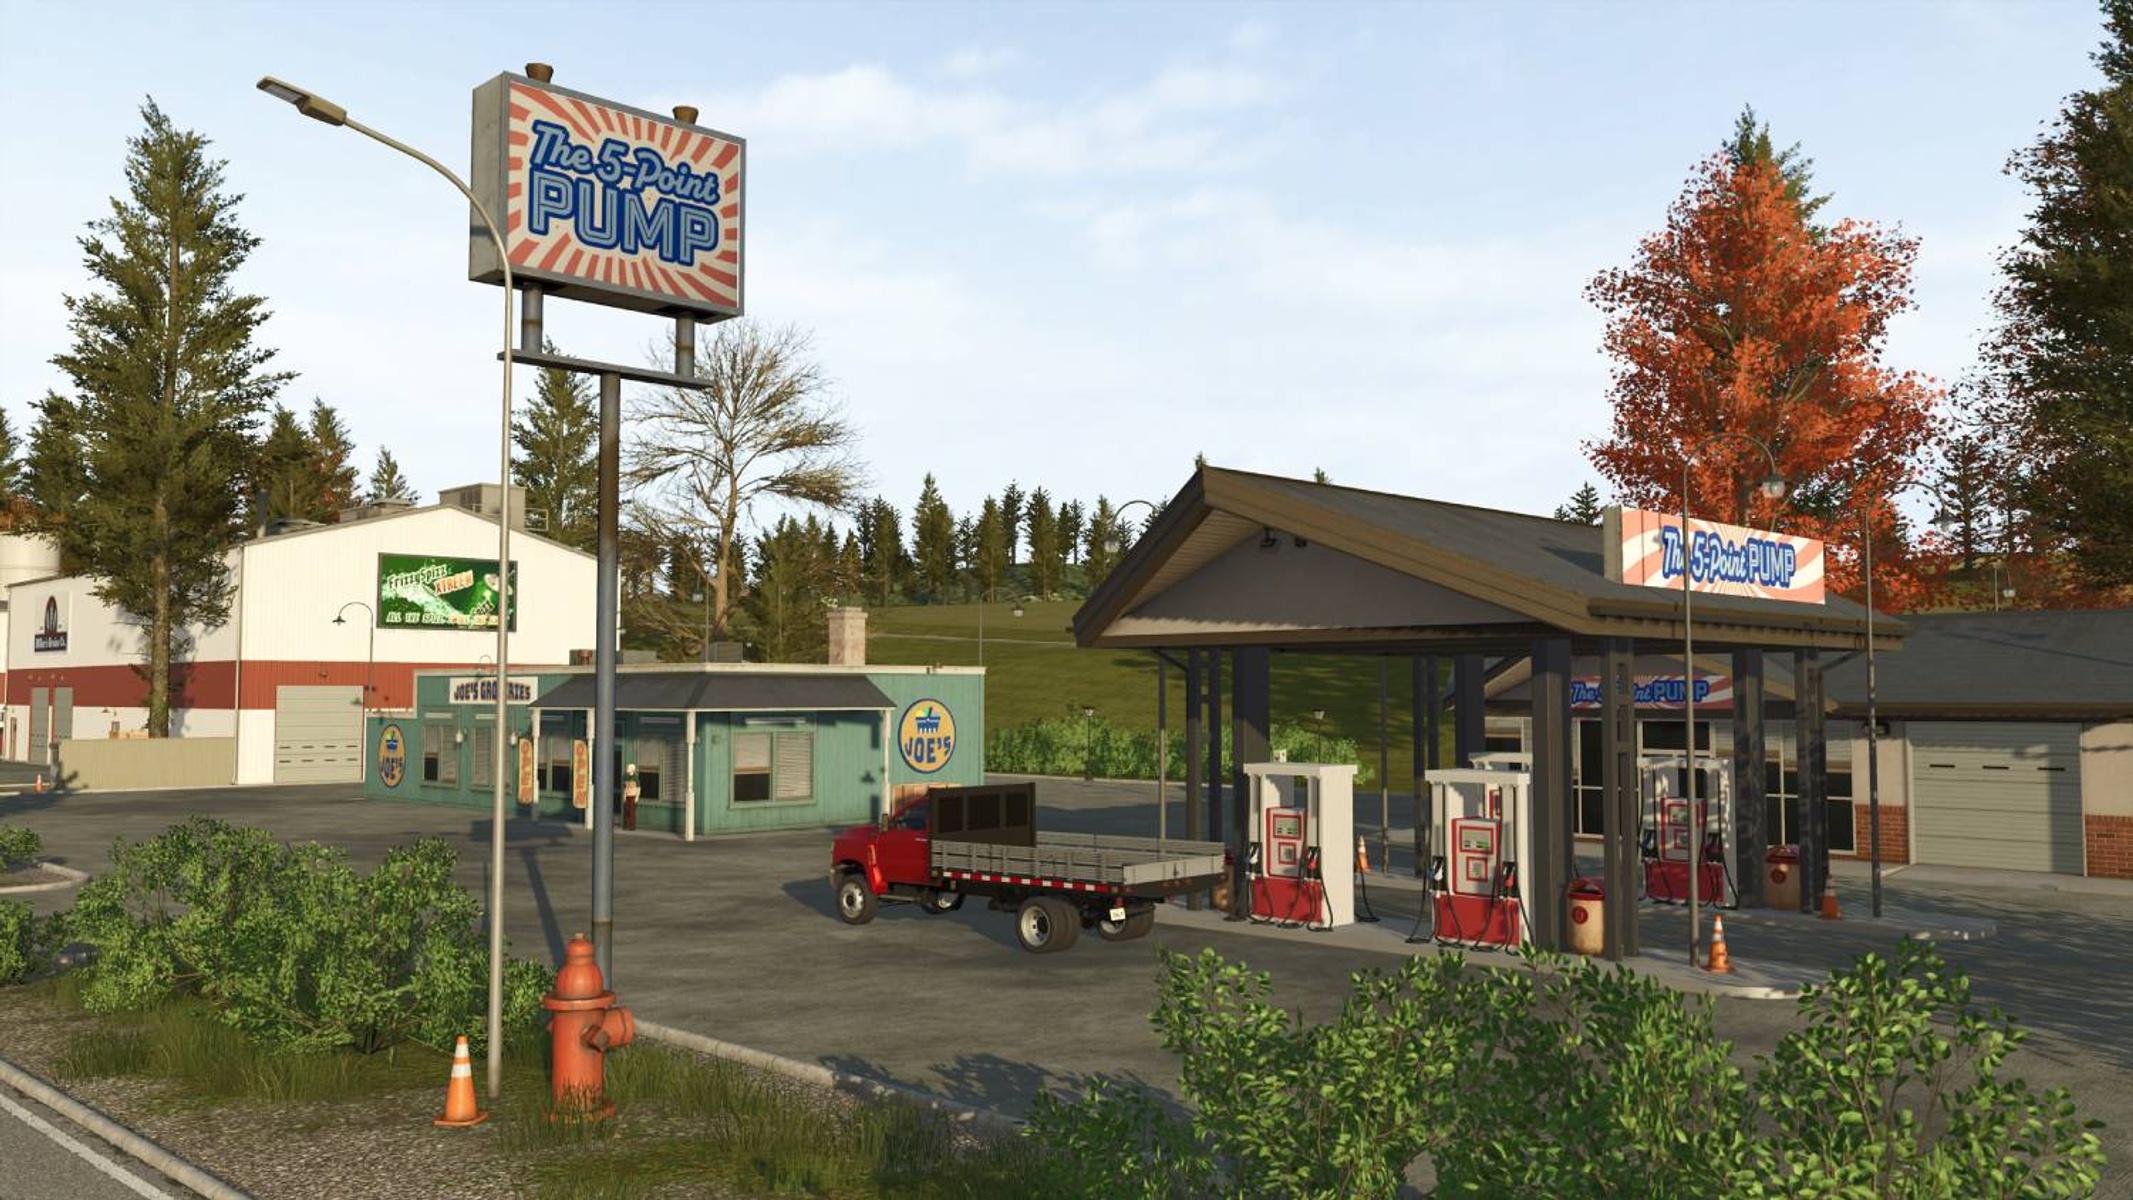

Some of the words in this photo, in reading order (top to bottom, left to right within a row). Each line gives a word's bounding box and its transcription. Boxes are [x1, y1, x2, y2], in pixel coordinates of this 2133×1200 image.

[530, 119, 594, 173] The
[596, 138, 720, 204] 5-Point
[529, 167, 719, 267] PUMP
[1692, 531, 1749, 584] 5-Point
[1746, 537, 1796, 588] PUMP
[454, 682, 479, 701] JOE'S
[480, 680, 531, 701] GRORIES
[1571, 682, 1599, 704] The
[905, 736, 952, 763] JOE'S
